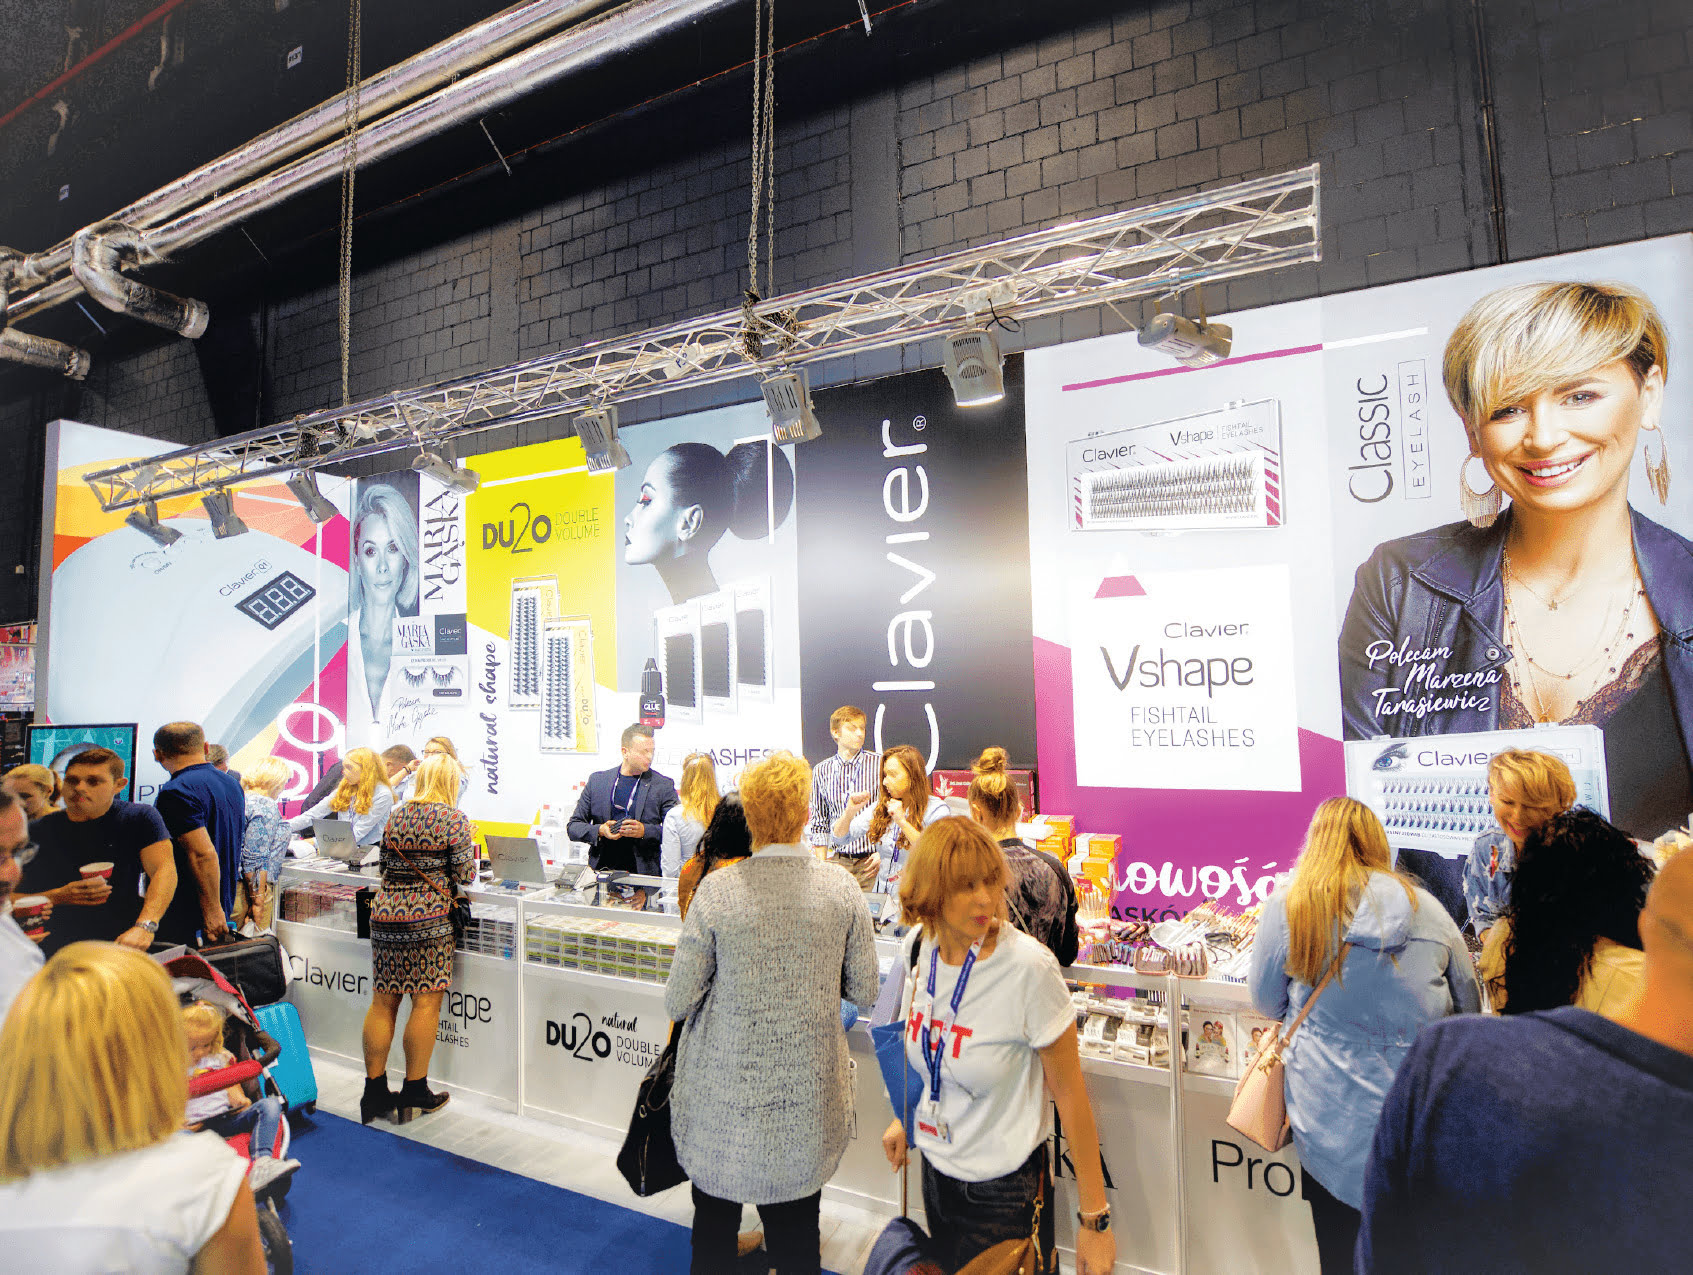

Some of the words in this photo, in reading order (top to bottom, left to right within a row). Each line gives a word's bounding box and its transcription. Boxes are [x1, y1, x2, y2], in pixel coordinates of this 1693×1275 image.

[1170, 430, 1214, 446] Vshape
[1221, 421, 1252, 433] FISHTAIL
[1221, 427, 1264, 440] EYELASHES
[1348, 374, 1394, 503] Classic
[1406, 374, 1425, 487] EYELASH
[1082, 444, 1136, 463] Clavier
[555, 507, 599, 526] DOUBLE
[555, 523, 600, 541] VOLUME
[219, 568, 258, 597] Clavier
[872, 419, 940, 776] Clavier
[1163, 622, 1250, 638] Clavier
[1365, 635, 1453, 670] Polecam
[478, 643, 501, 705] shape
[1099, 644, 1254, 699] Vshape
[1403, 662, 1502, 693] Marzena
[1131, 706, 1218, 724] FISHTAIL
[1372, 687, 1491, 718] Tarasiewicz
[1131, 728, 1255, 747] EYELASHES
[480, 712, 499, 795] natural
[1113, 856, 1278, 906] owość
[1110, 905, 1188, 924] ASKÓ
[289, 955, 368, 995] Clavier
[601, 1011, 638, 1032] natural
[616, 1035, 660, 1057] DOUBLE
[616, 1050, 653, 1068] VOLUM
[1211, 1139, 1295, 1197] Pro
